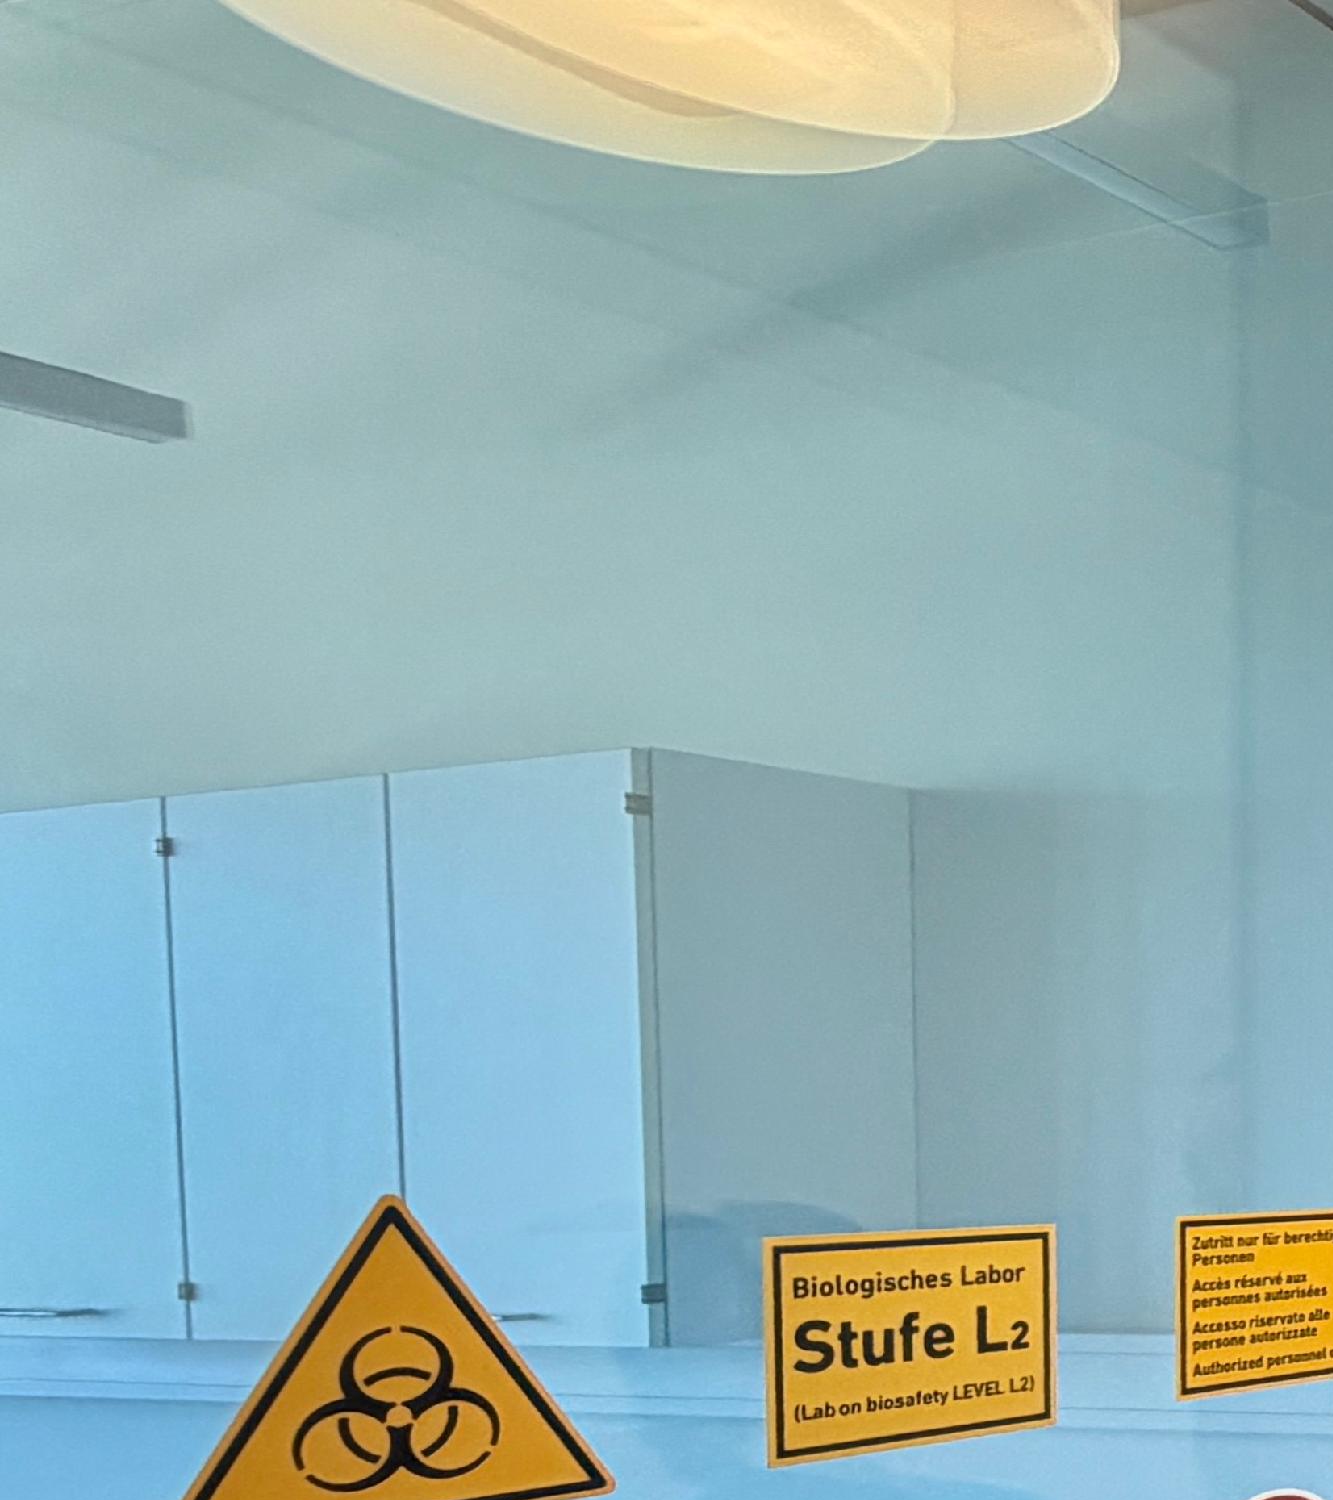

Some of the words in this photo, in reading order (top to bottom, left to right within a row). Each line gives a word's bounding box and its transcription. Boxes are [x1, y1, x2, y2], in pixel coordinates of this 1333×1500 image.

[1191, 1235, 1234, 1251] Zutritt
[1237, 1236, 1259, 1247] nur
[1262, 1232, 1280, 1246] für
[1191, 1252, 1255, 1267] Personen
[793, 1270, 952, 1299] Biologisches
[961, 1264, 1025, 1286] Labor
[1192, 1277, 1231, 1292] Accès
[1234, 1272, 1283, 1288] réservé
[1285, 1273, 1307, 1284] aux
[1192, 1292, 1260, 1312] personnes
[1264, 1284, 1327, 1301] autorisées
[1192, 1320, 1246, 1334] Accesso
[1308, 1308, 1331, 1322] alle
[794, 1311, 955, 1374] Stufe
[976, 1305, 1030, 1355] L2
[1192, 1333, 1246, 1354] persone
[1249, 1326, 1318, 1343] autorizzate
[1266, 1347, 1327, 1369] personnel
[838, 1402, 862, 1417] on
[866, 1389, 949, 1413] biosafety
[953, 1382, 1004, 1402] LEVEL
[1009, 1374, 1036, 1394] L2)
